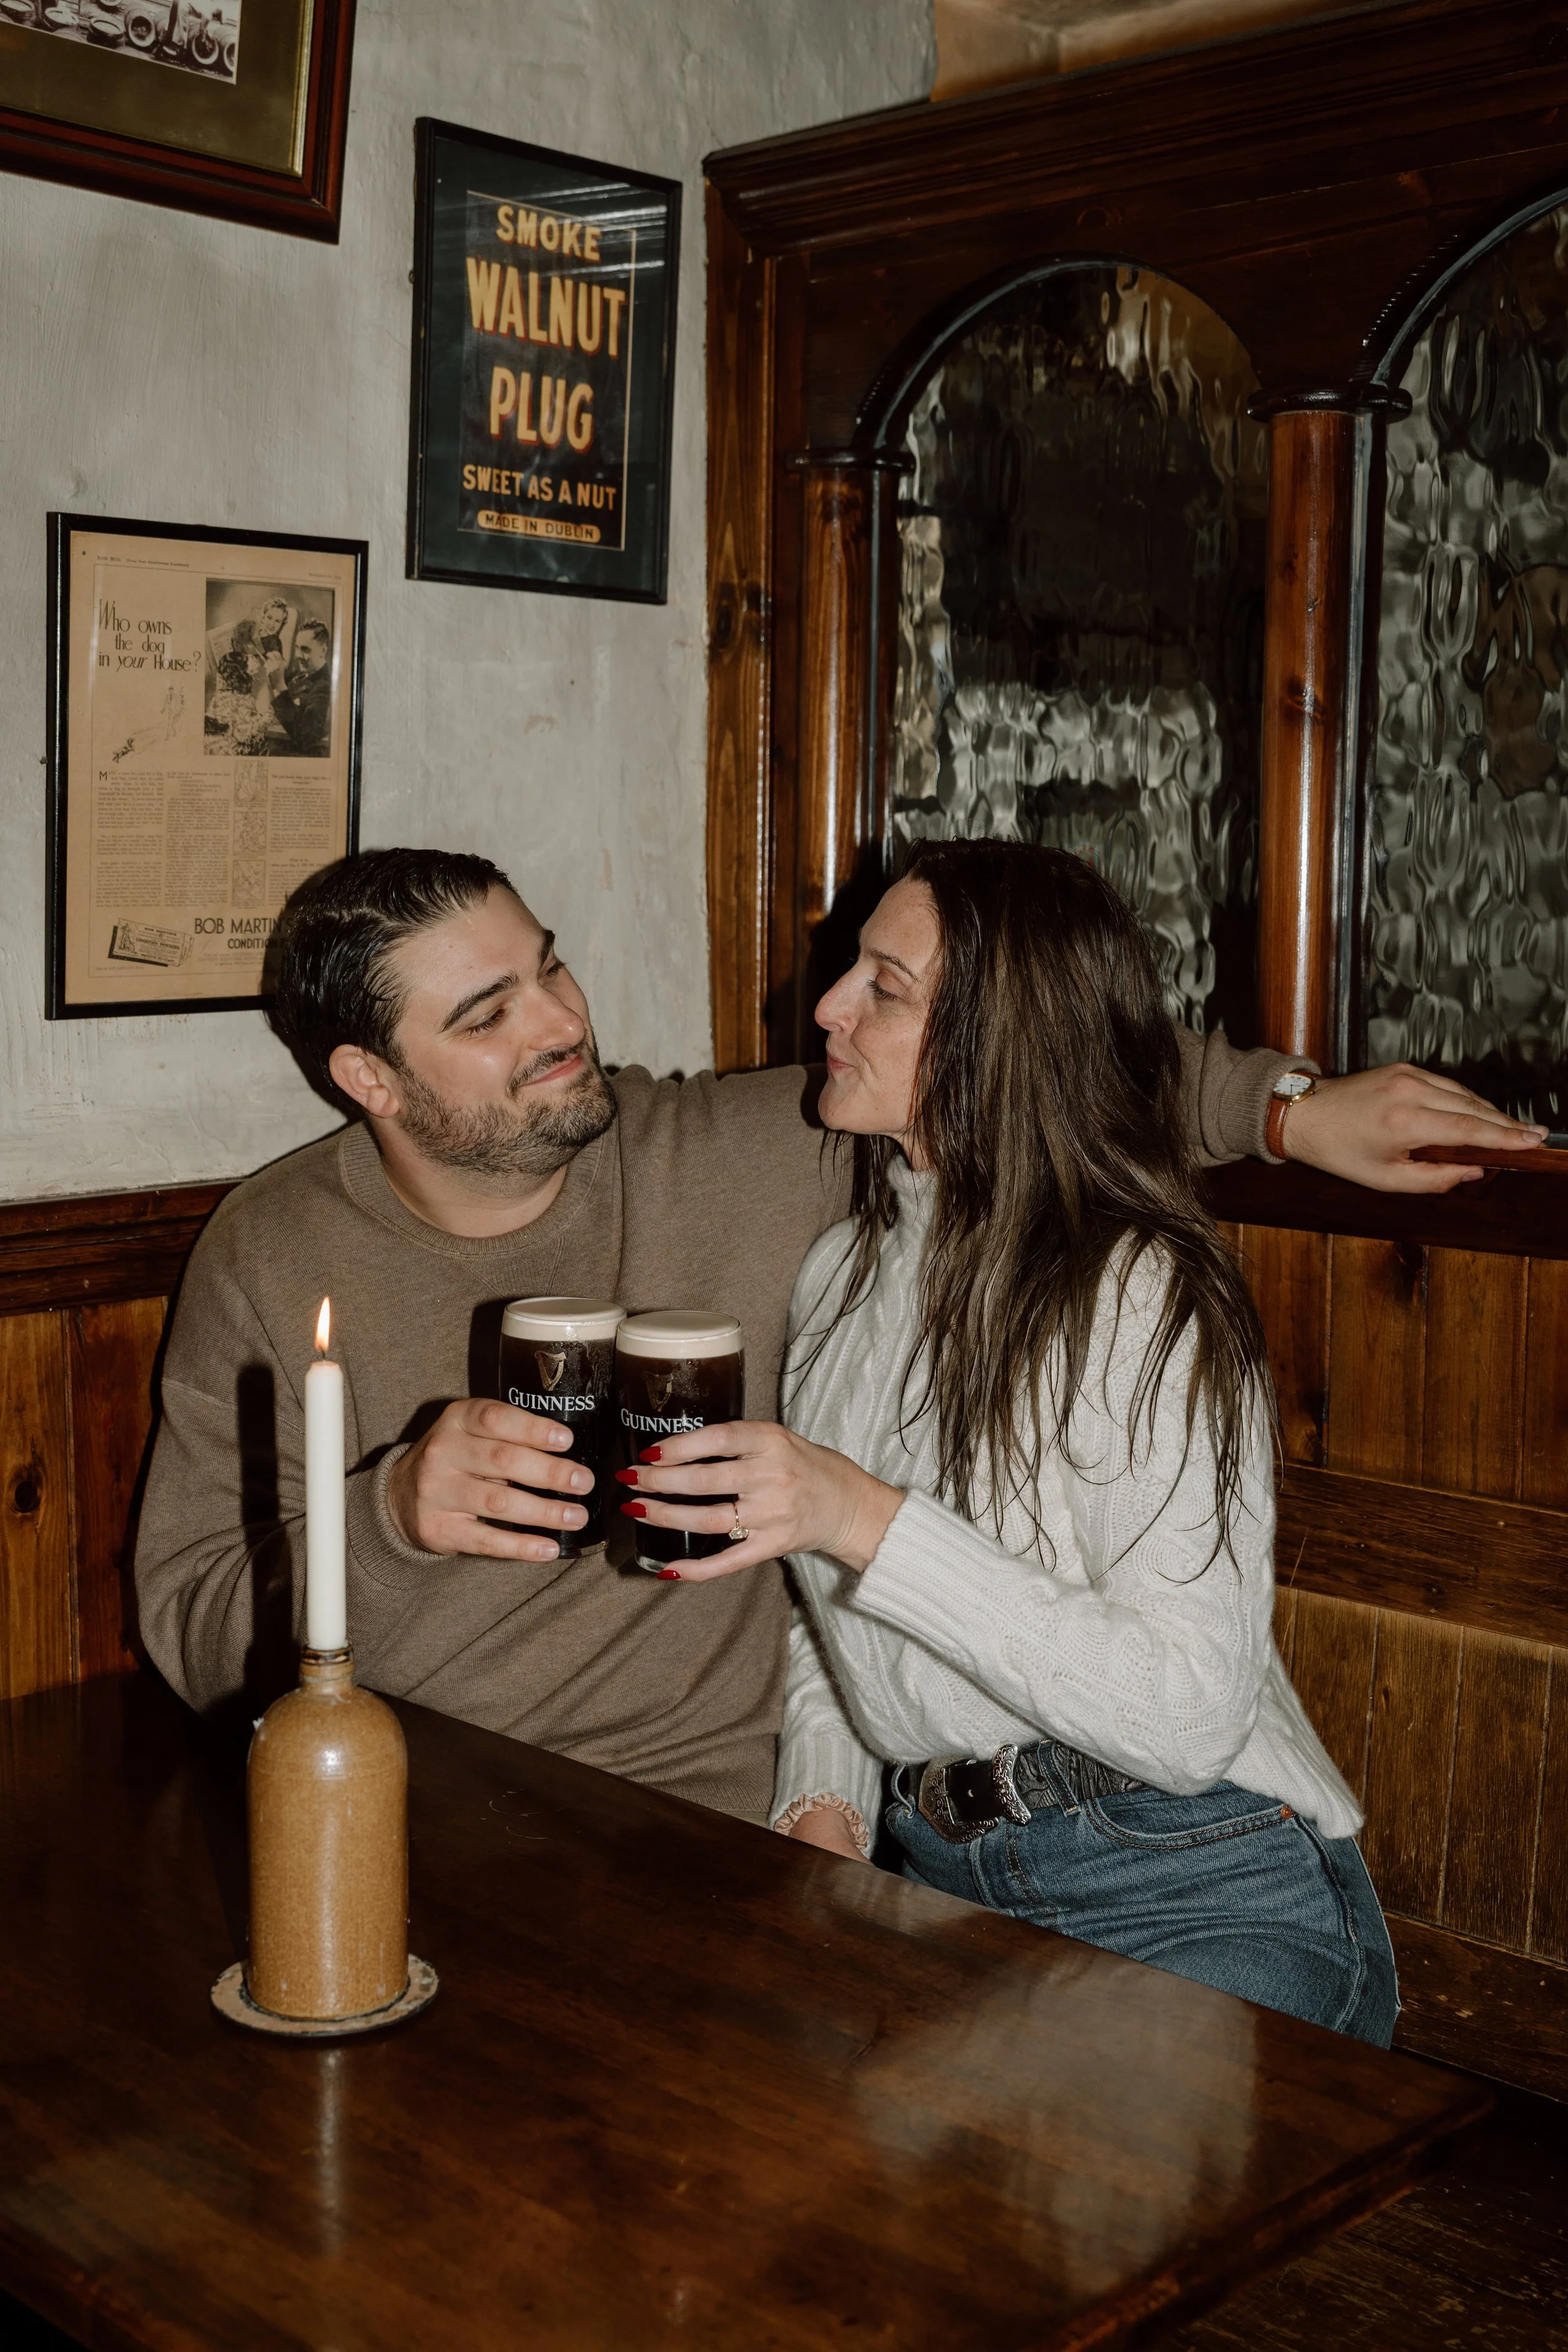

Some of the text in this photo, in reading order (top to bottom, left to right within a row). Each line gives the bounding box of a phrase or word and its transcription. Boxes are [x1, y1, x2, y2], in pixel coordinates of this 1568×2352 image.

[495, 204, 603, 263] SMOKE
[465, 256, 627, 361] WALNUT
[489, 366, 594, 455] PLUG
[462, 464, 617, 511] SWEET AS A NUT
[485, 514, 595, 540] MADE IN DUBLIN
[99, 599, 172, 635] Who owns
[115, 632, 165, 655] the dog
[98, 650, 202, 673] in your House?
[194, 918, 225, 934] BOB
[508, 1387, 595, 1411] GUINNESS
[620, 1408, 704, 1433] GUINNESS
